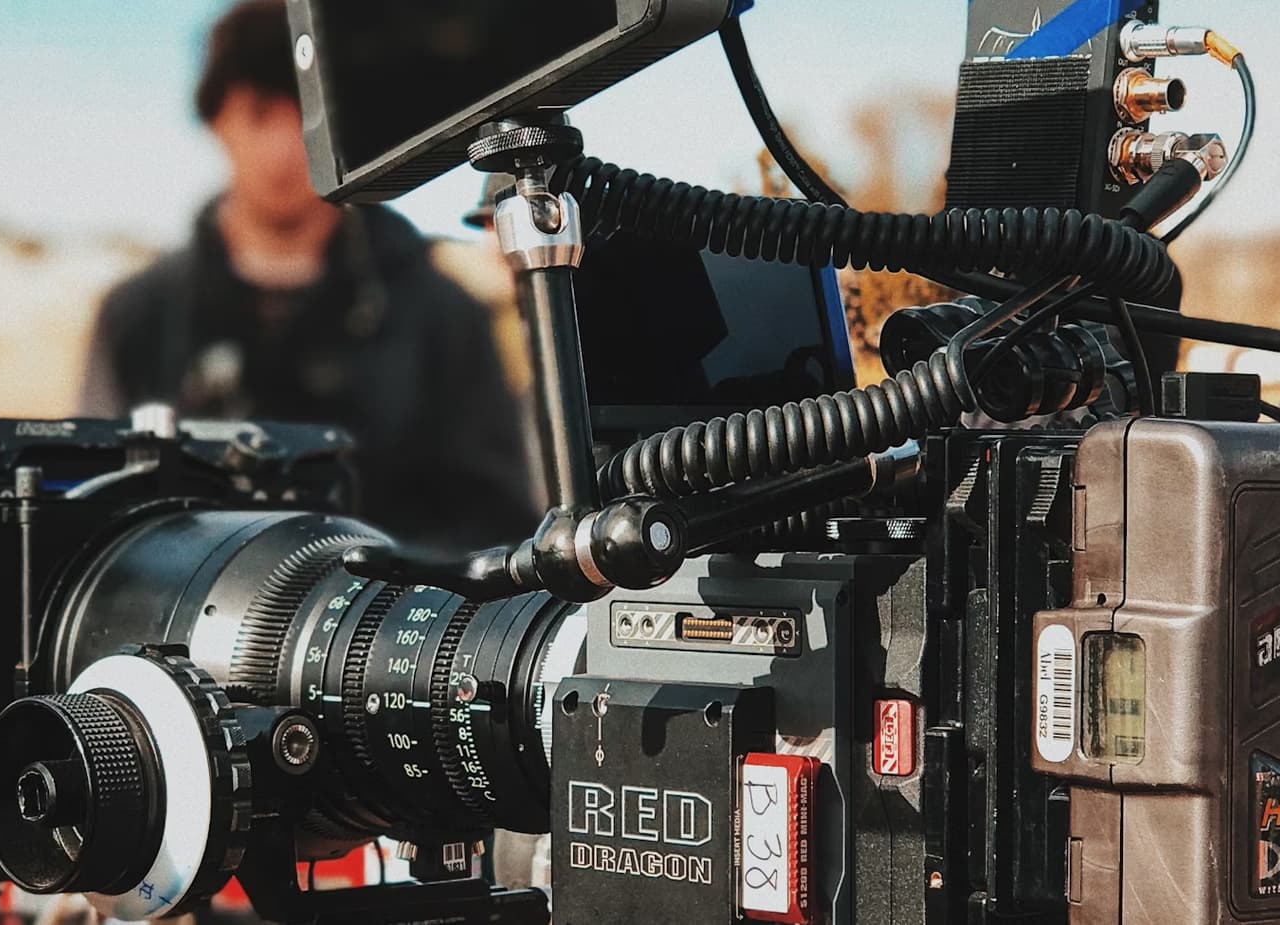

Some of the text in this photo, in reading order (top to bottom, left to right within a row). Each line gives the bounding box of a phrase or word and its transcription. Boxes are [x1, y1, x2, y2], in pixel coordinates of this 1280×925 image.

[407, 608, 431, 622] 180
[323, 617, 334, 632] 6
[396, 630, 420, 645] 160
[388, 658, 411, 674] 140
[463, 654, 472, 667] T
[309, 684, 317, 700] 5
[384, 693, 405, 709] 120
[1039, 694, 1049, 738] G9832
[388, 733, 411, 750] 100
[458, 727, 467, 740] 8
[456, 744, 471, 758] 11
[403, 763, 422, 778] 85
[461, 761, 477, 773] 16
[744, 781, 778, 815] B
[568, 780, 712, 847] RED
[800, 839, 808, 863] RED
[570, 842, 712, 885] DRAGON
